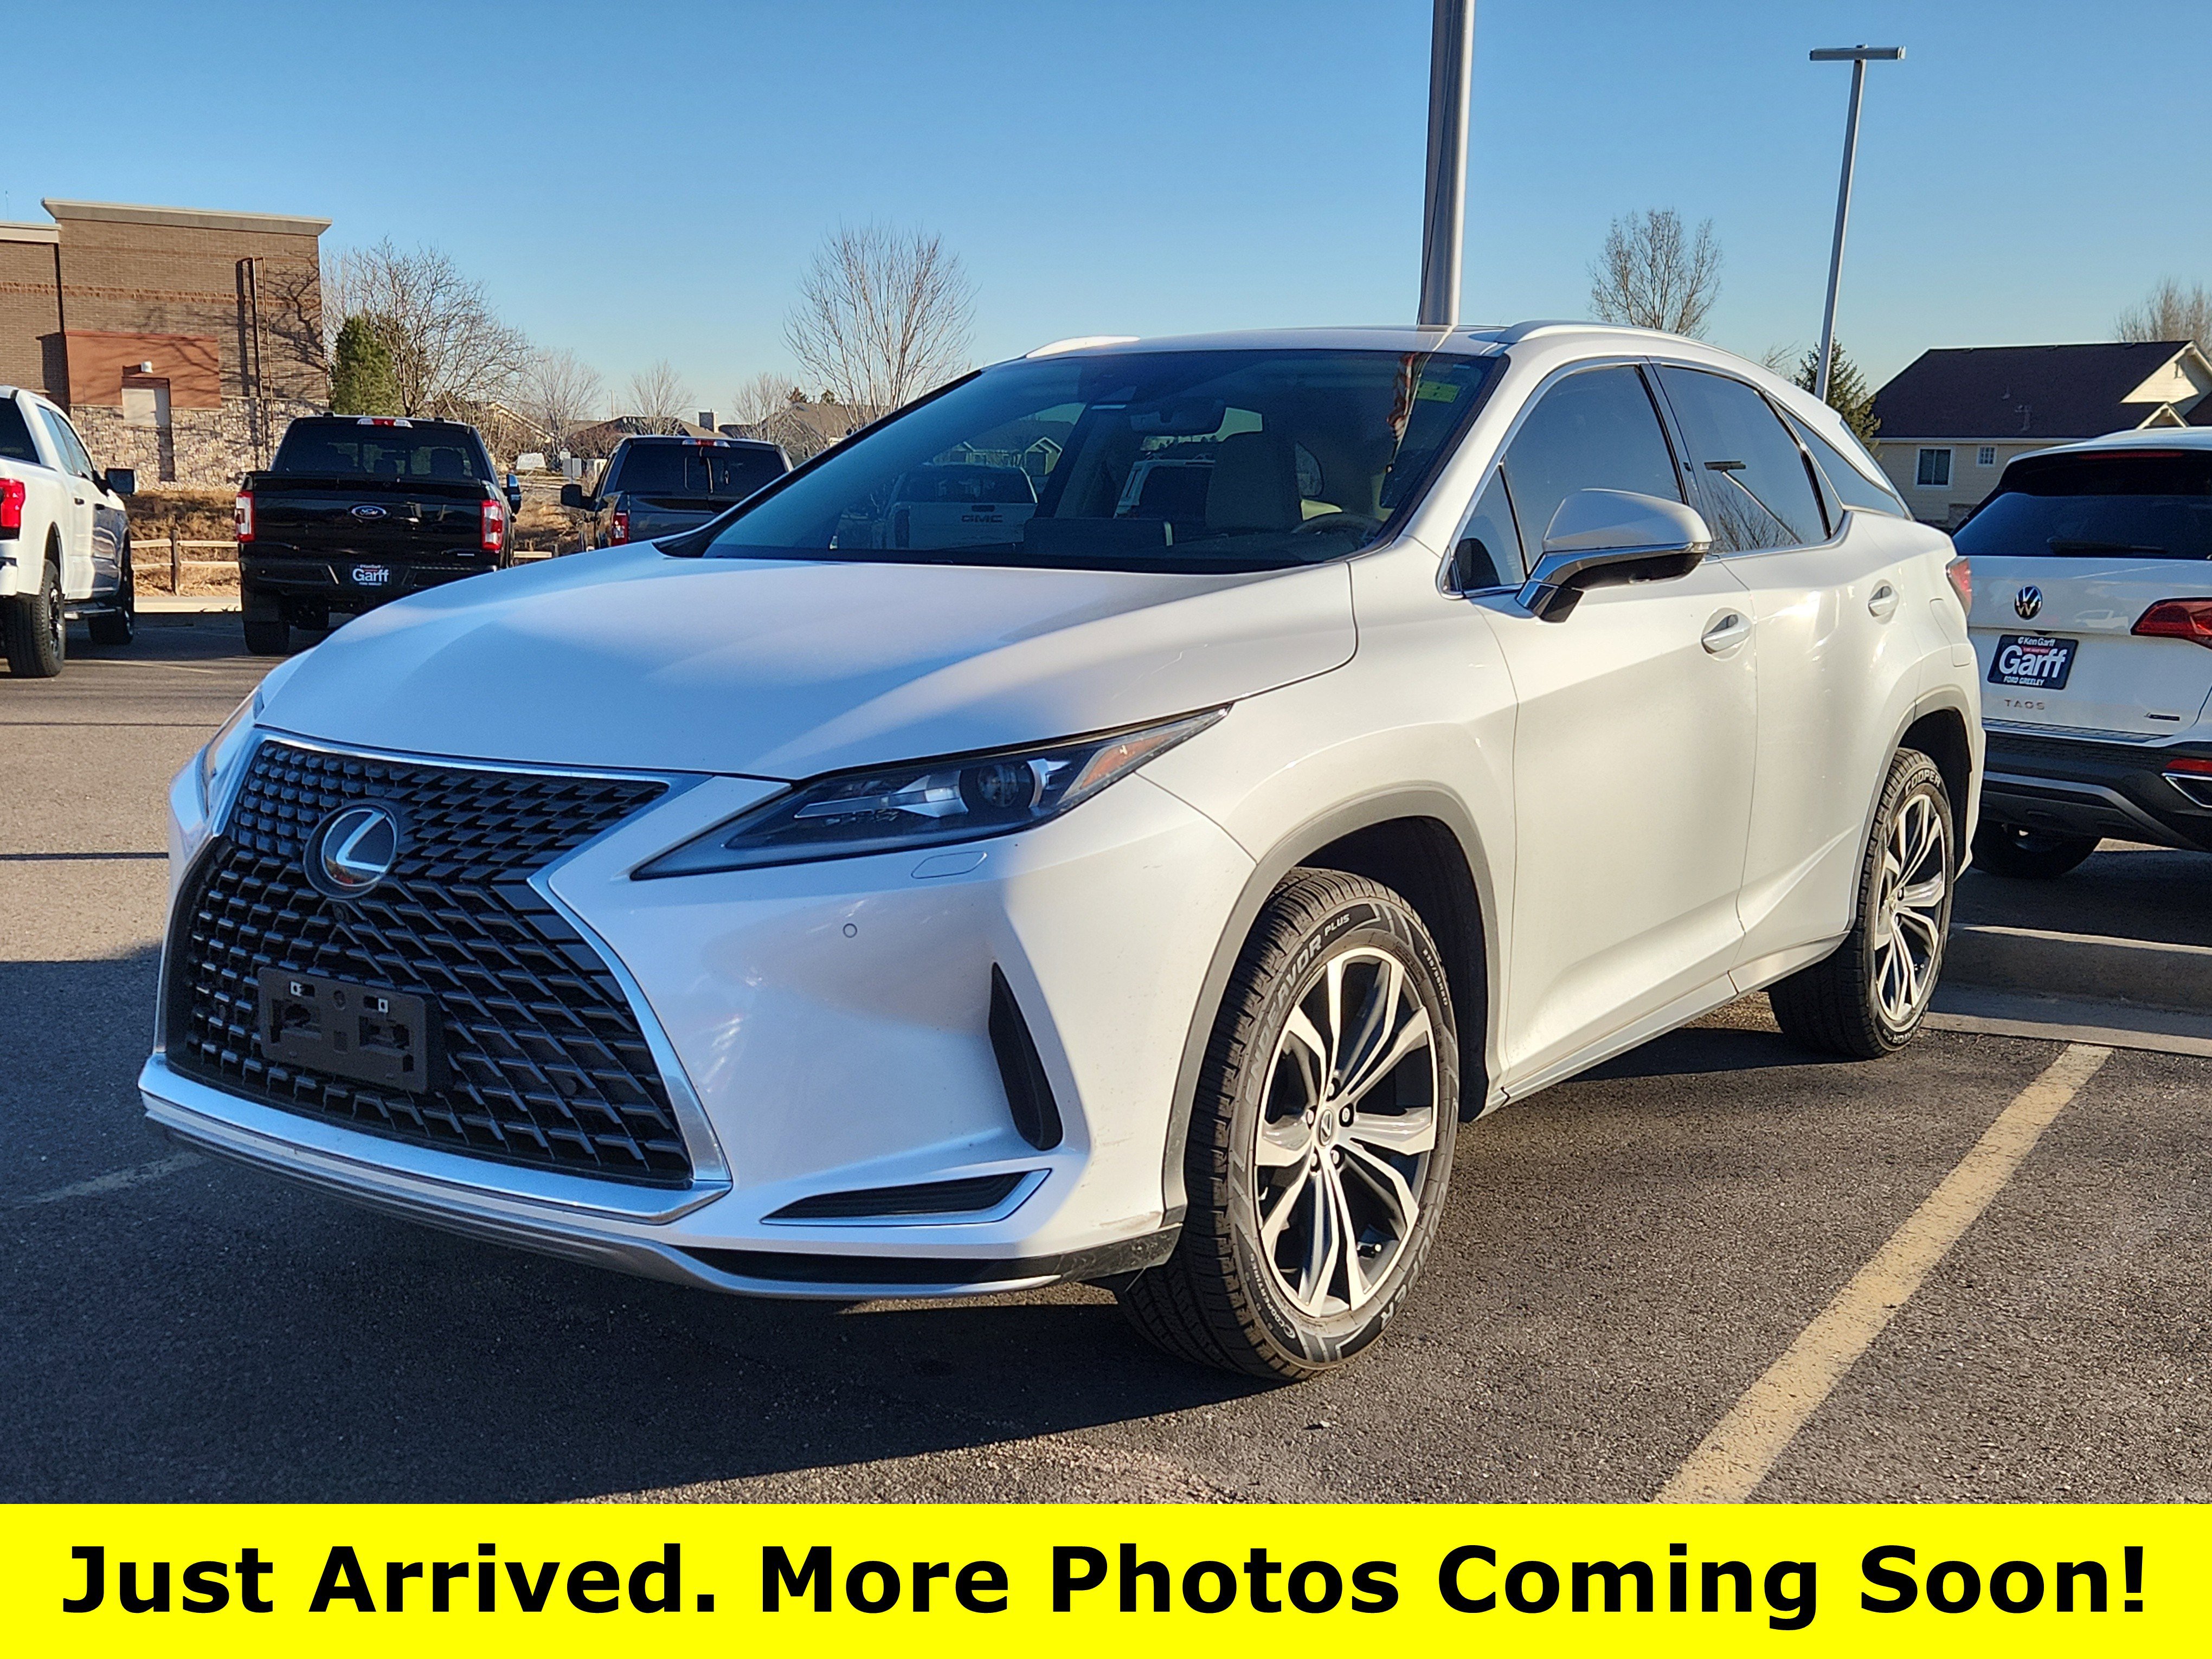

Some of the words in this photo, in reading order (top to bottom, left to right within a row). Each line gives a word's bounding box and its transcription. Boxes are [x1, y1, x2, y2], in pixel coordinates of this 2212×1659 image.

[961, 515, 1003, 523] GMC
[352, 568, 389, 582] Garff
[2023, 636, 2037, 646] Ken
[2037, 638, 2056, 647] Garff
[1999, 645, 2068, 678] Garff
[2004, 699, 2045, 710] TAOS
[1905, 769, 1941, 796] COOPER
[1245, 934, 1322, 1104] ENDEAVOR
[1324, 914, 1351, 936] PLUS
